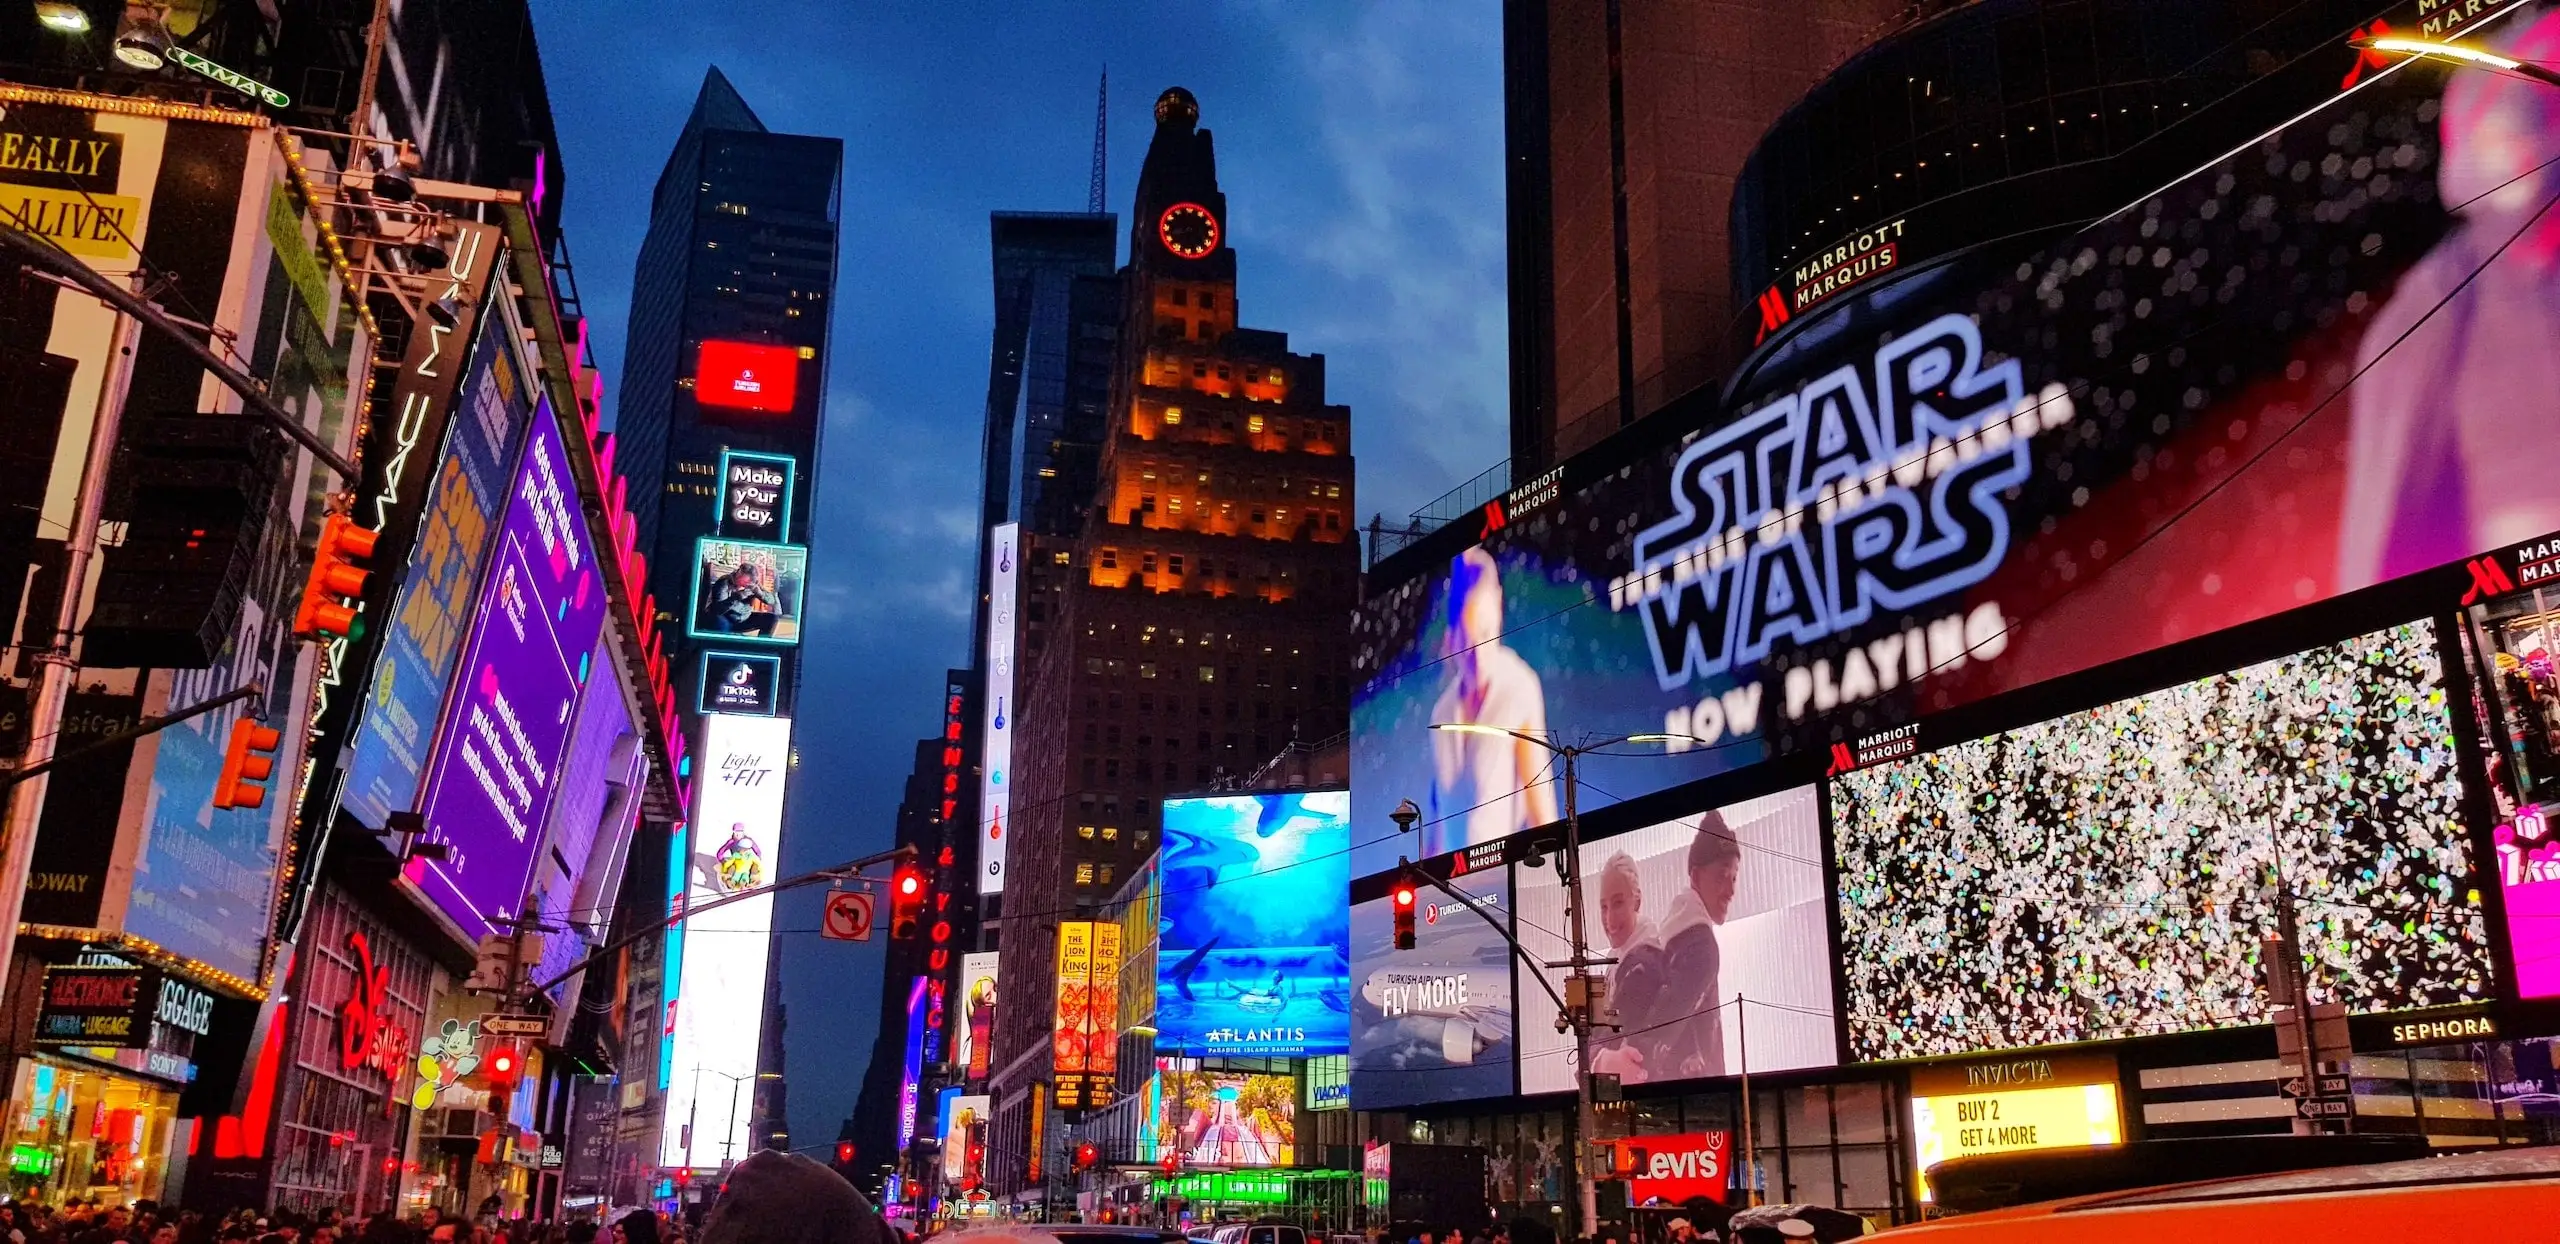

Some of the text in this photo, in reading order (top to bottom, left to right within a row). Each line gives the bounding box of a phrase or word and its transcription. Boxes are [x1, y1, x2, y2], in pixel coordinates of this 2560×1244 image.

[180, 52, 278, 103] LAMAR
[0, 132, 109, 176] EALLY
[13, 198, 124, 242] ALIVE!
[1796, 219, 1905, 286] MARRIOTT
[1797, 249, 1892, 308] MARQUIS
[1633, 313, 2022, 562] STAR
[1818, 382, 2076, 523] SKYWALKER
[734, 467, 783, 486] Make
[1509, 466, 1564, 504] MARRIOTT
[522, 470, 538, 508] you
[736, 487, 778, 505] your
[438, 454, 487, 571] COME
[1509, 485, 1558, 519] MARQUIS
[737, 507, 773, 525] day.
[1638, 440, 2031, 691] WARS
[1665, 602, 2008, 754] NOW PLAYING
[724, 685, 757, 696] TikTok
[1859, 723, 1920, 749] MARRIOTT
[721, 752, 762, 771] Light
[941, 694, 965, 820] ERNST
[1860, 740, 1914, 763] MARQUIS
[722, 769, 772, 789] +FIT
[1469, 840, 1506, 858] MARRIOTT
[1470, 852, 1502, 869] MARQUIS
[1439, 893, 1498, 917] TURKISH IRLINES
[1064, 944, 1086, 957] LION
[1068, 935, 1083, 944] THE
[927, 893, 951, 1029] YOUNG
[1062, 958, 1088, 973] KING
[1387, 974, 1417, 985] TURKISH
[153, 977, 214, 1036] UGGAGE
[1383, 973, 1468, 1017] FLY MORE
[44, 1014, 131, 1035] CAMERA LUGGAGE
[489, 1021, 539, 1031] ONE WAY
[1206, 1027, 1305, 1043] ATLANTIS
[2393, 1017, 2493, 1042] SEPHORA
[1208, 1046, 1242, 1054] PARADISE
[150, 1053, 179, 1075] SONY
[1965, 1059, 2054, 1087] INVICTA
[2290, 1082, 2305, 1092] ON
[1958, 1099, 2000, 1122] BUY 2
[2304, 1104, 2342, 1113] ONE WAY
[1960, 1125, 2037, 1147] GET 4 MORE
